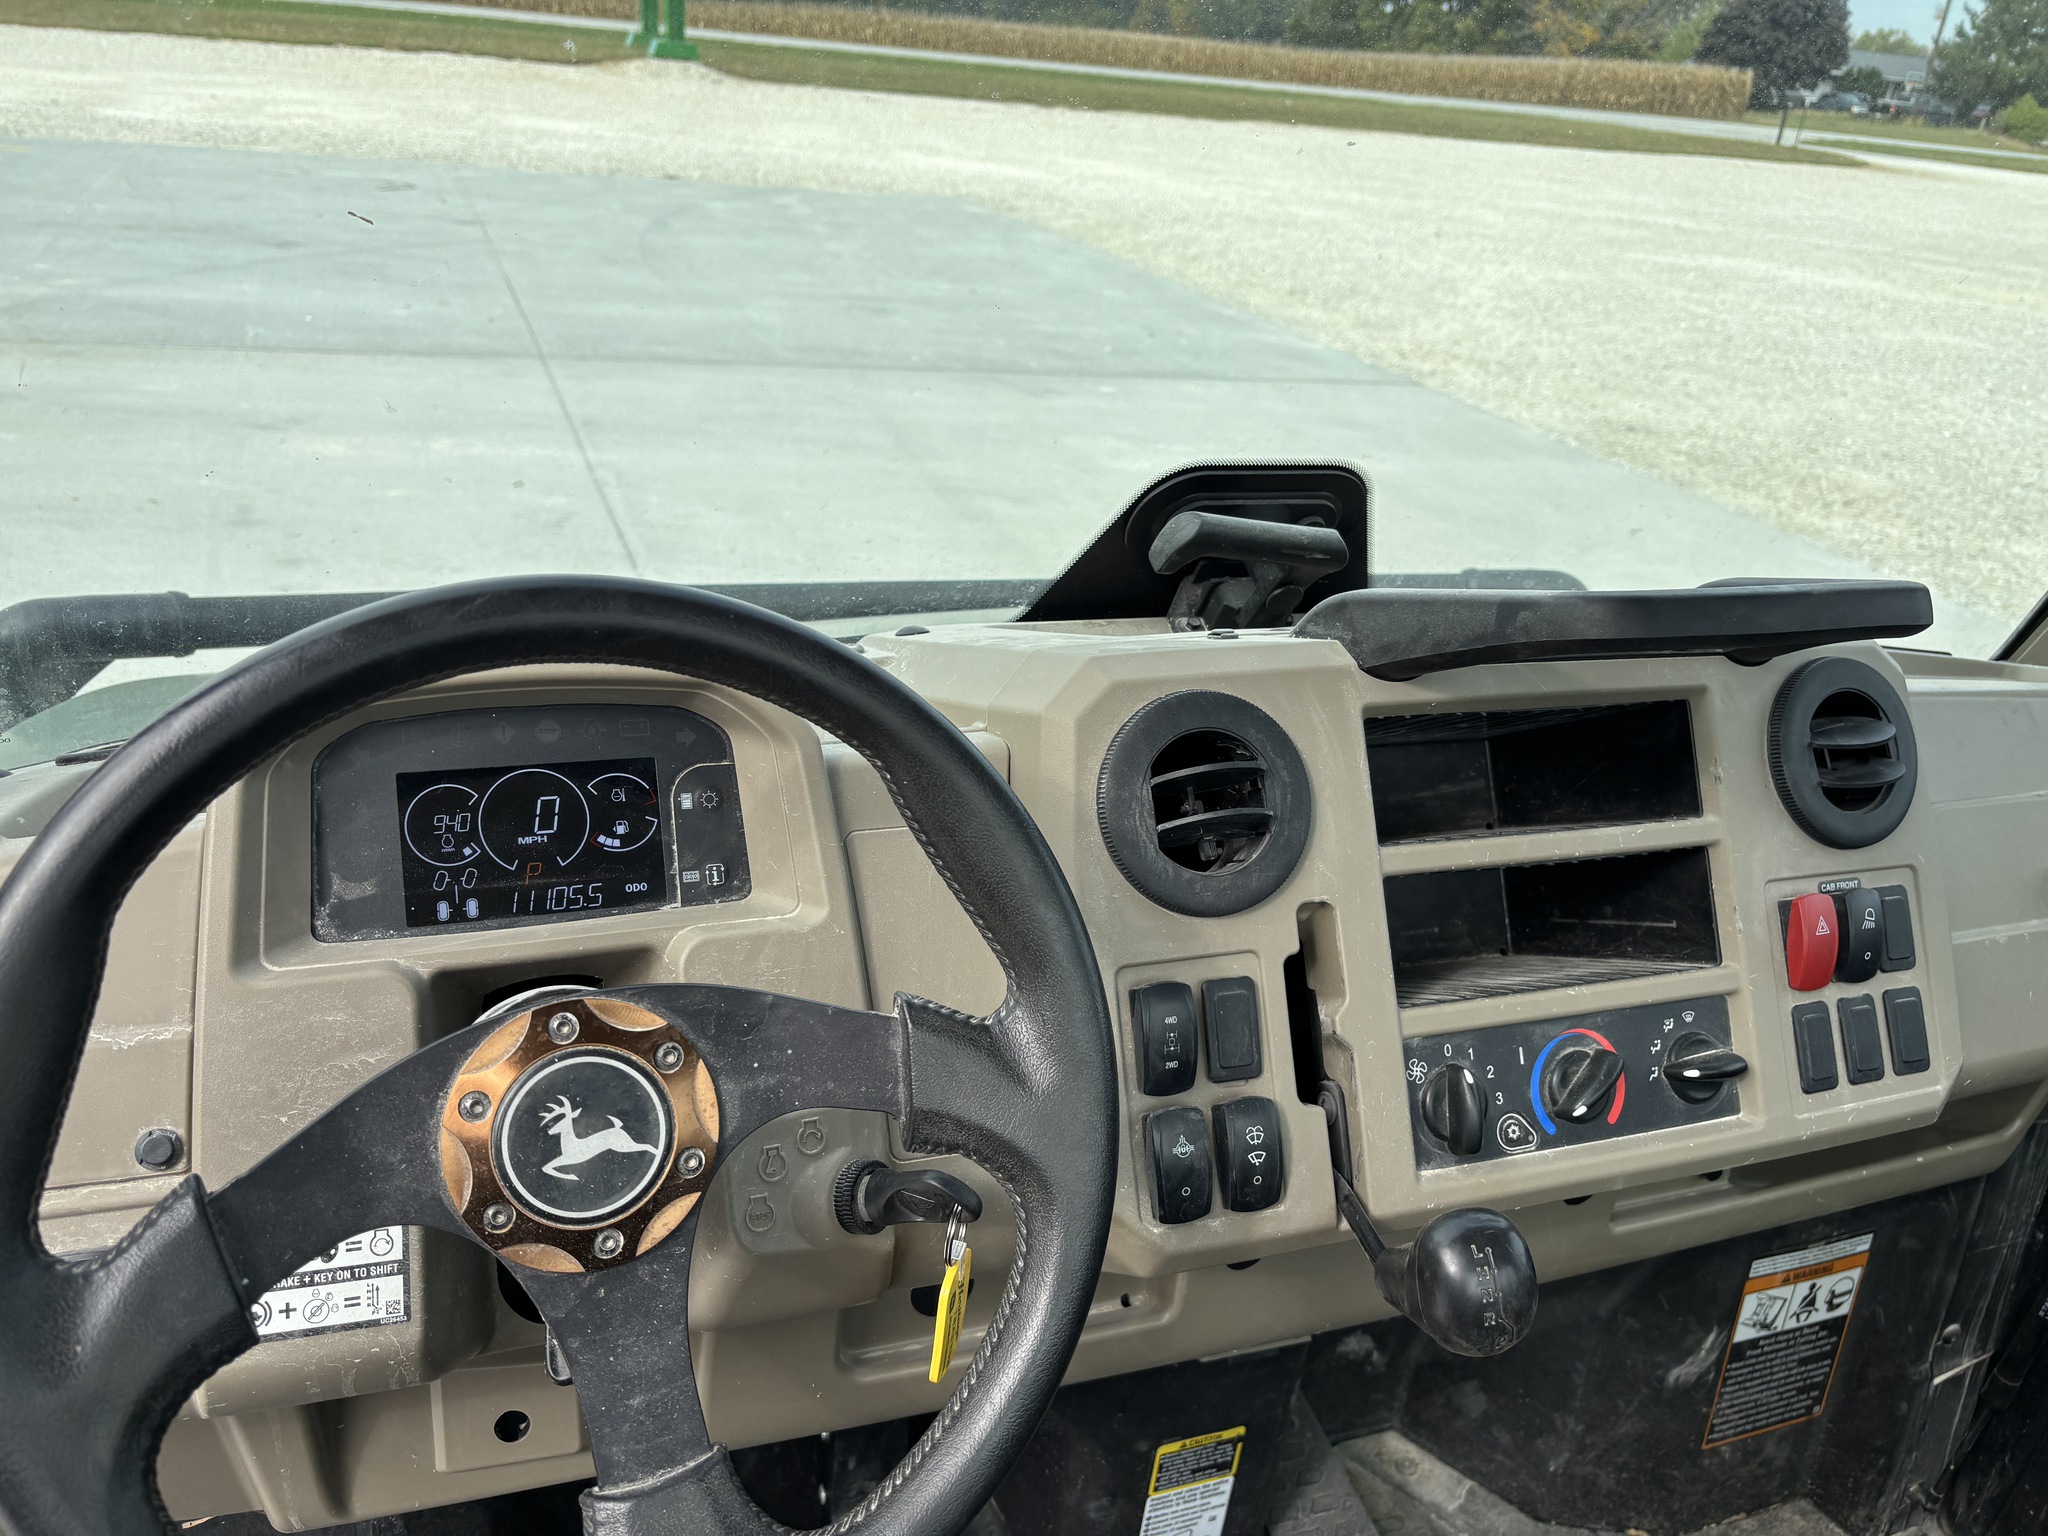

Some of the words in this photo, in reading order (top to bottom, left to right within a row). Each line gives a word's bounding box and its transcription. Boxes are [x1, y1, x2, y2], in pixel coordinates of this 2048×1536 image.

[534, 795, 560, 835] 0
[433, 813, 471, 835] 940
[517, 835, 548, 845] MPH
[525, 862, 542, 886] P
[1821, 882, 1836, 892] CAB
[1836, 880, 1859, 891] FRONT
[513, 883, 602, 914] 11105.5
[625, 882, 648, 893] ODO
[1164, 1015, 1178, 1025] 4WD
[1444, 1043, 1452, 1057] 0
[1467, 1047, 1474, 1060] 1
[1165, 1060, 1179, 1069] 2WD
[1486, 1065, 1495, 1078] 2
[1495, 1091, 1504, 1105] 3
[1470, 1244, 1484, 1259] L
[273, 1276, 301, 1289] AKE
[313, 1272, 334, 1284] KEY
[336, 1269, 351, 1281] ON
[353, 1266, 367, 1278] TO
[369, 1263, 400, 1276] SHIFT
[1475, 1265, 1490, 1281] H
[1791, 1262, 1835, 1281] WARNING
[1480, 1288, 1494, 1303] N
[1483, 1312, 1496, 1327] R
